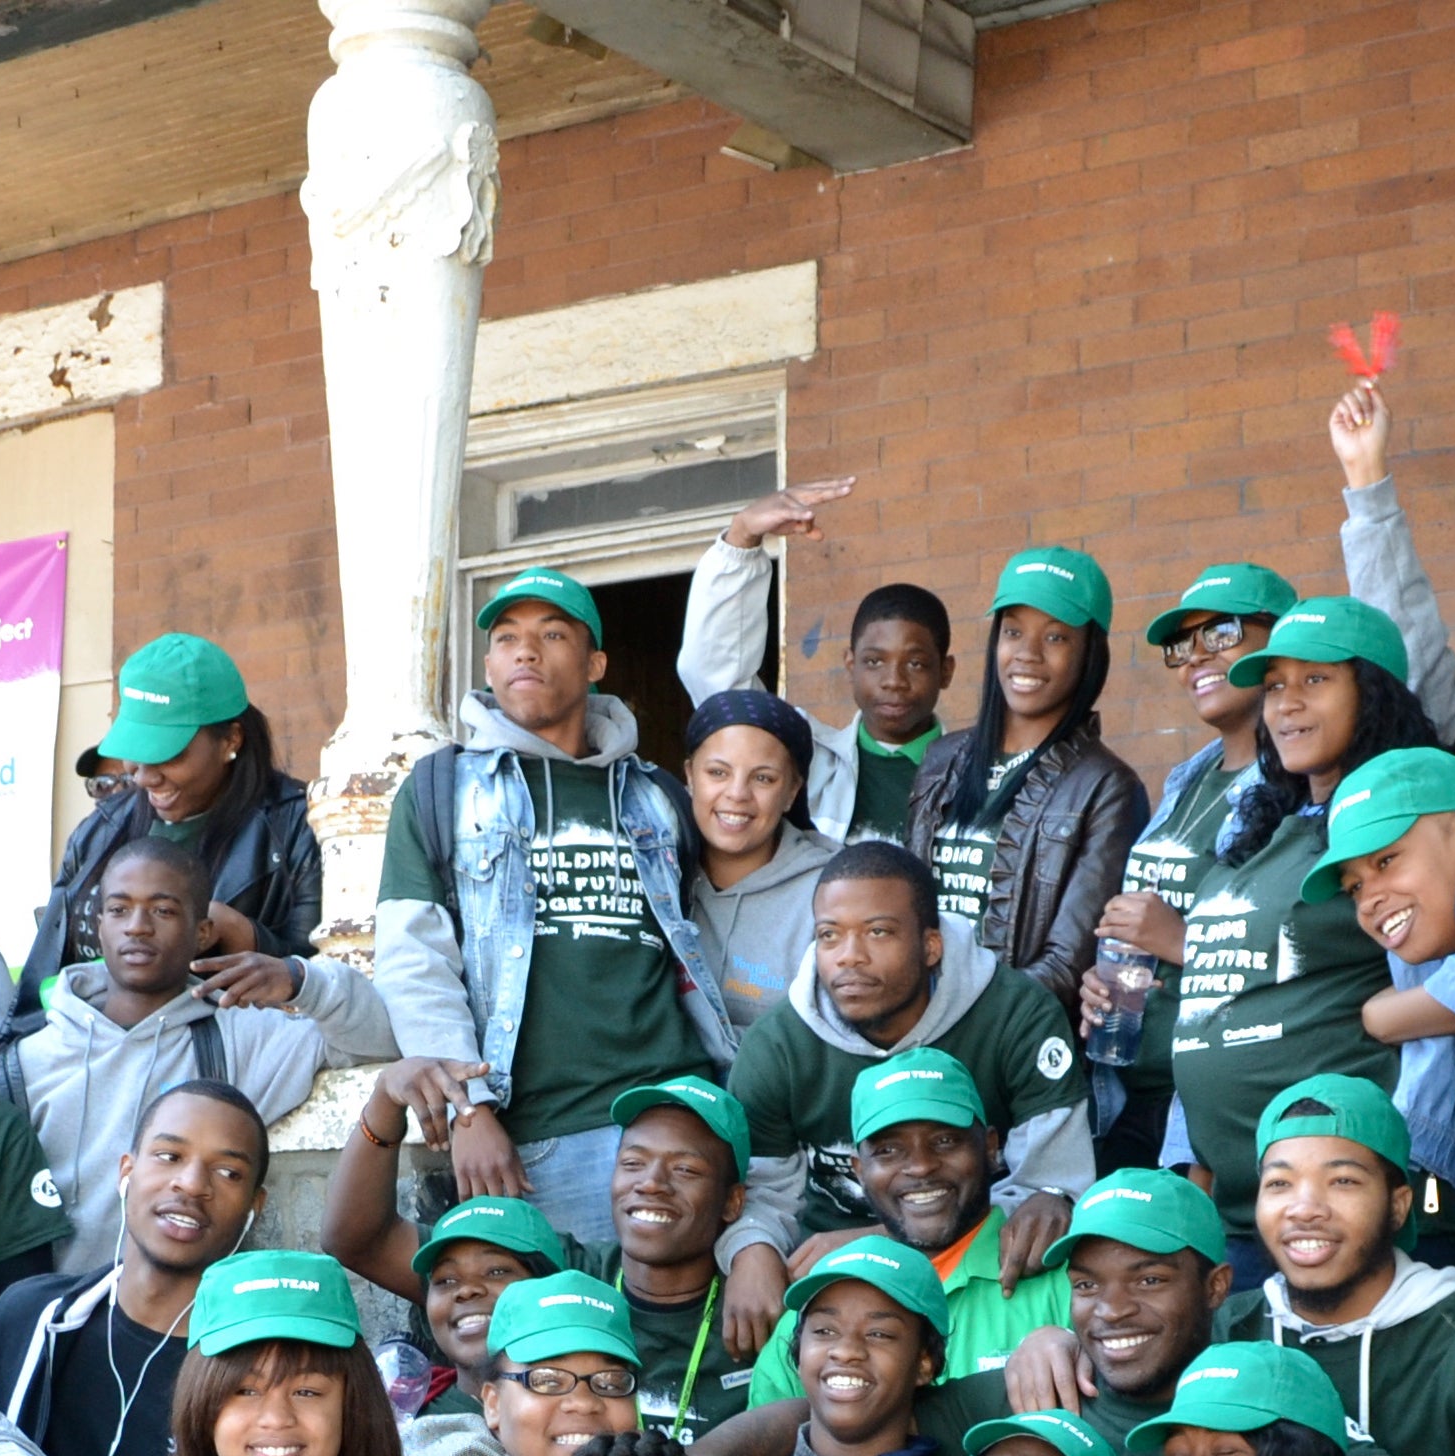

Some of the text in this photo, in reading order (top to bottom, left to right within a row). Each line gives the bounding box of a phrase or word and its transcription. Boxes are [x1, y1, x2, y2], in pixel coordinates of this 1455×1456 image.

[1047, 565, 1075, 580] TEAM
[527, 850, 636, 870] UILDING
[933, 846, 983, 866] LDING
[574, 874, 645, 896] FUTUR
[535, 894, 644, 916] OGETHER
[865, 1253, 900, 1270] TEAM
[281, 1278, 320, 1292] TEAM
[583, 1296, 615, 1313] TEAM
